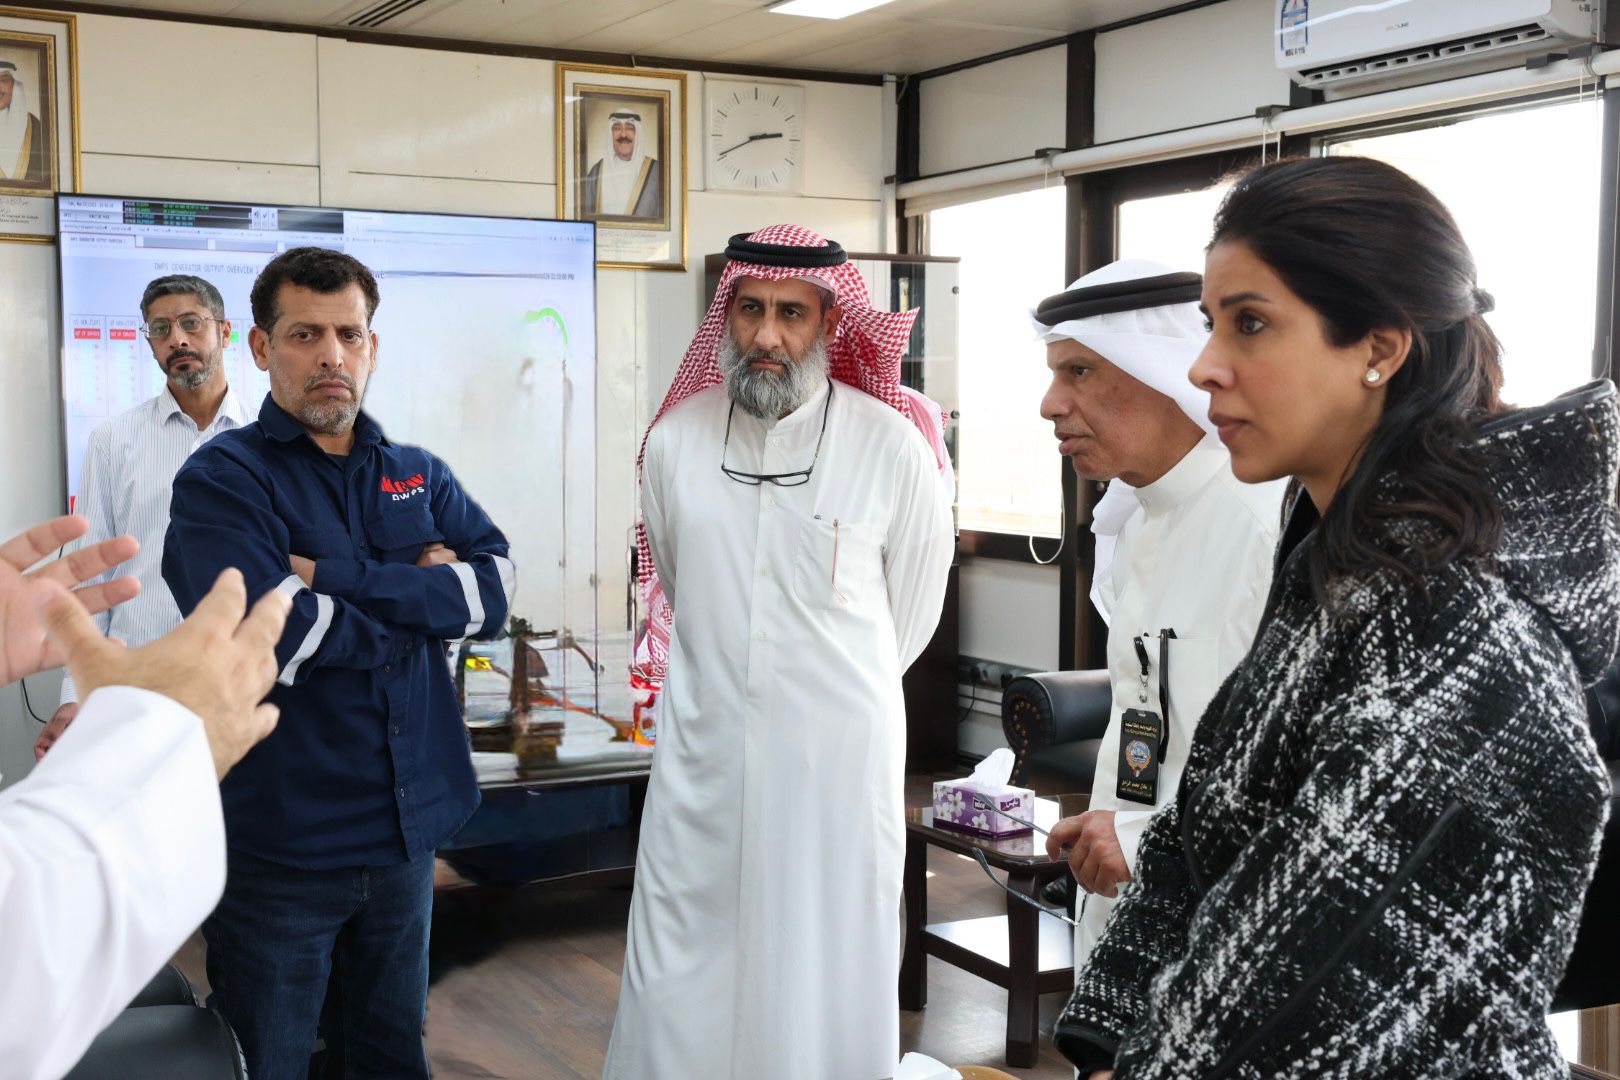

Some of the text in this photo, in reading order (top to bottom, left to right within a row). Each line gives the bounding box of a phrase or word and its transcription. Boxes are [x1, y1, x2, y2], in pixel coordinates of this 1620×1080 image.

[171, 263, 201, 272] GENERATOR
[204, 264, 225, 273] OUTPUT
[227, 264, 253, 274] OVERVIEW
[392, 486, 425, 501] DWPS
